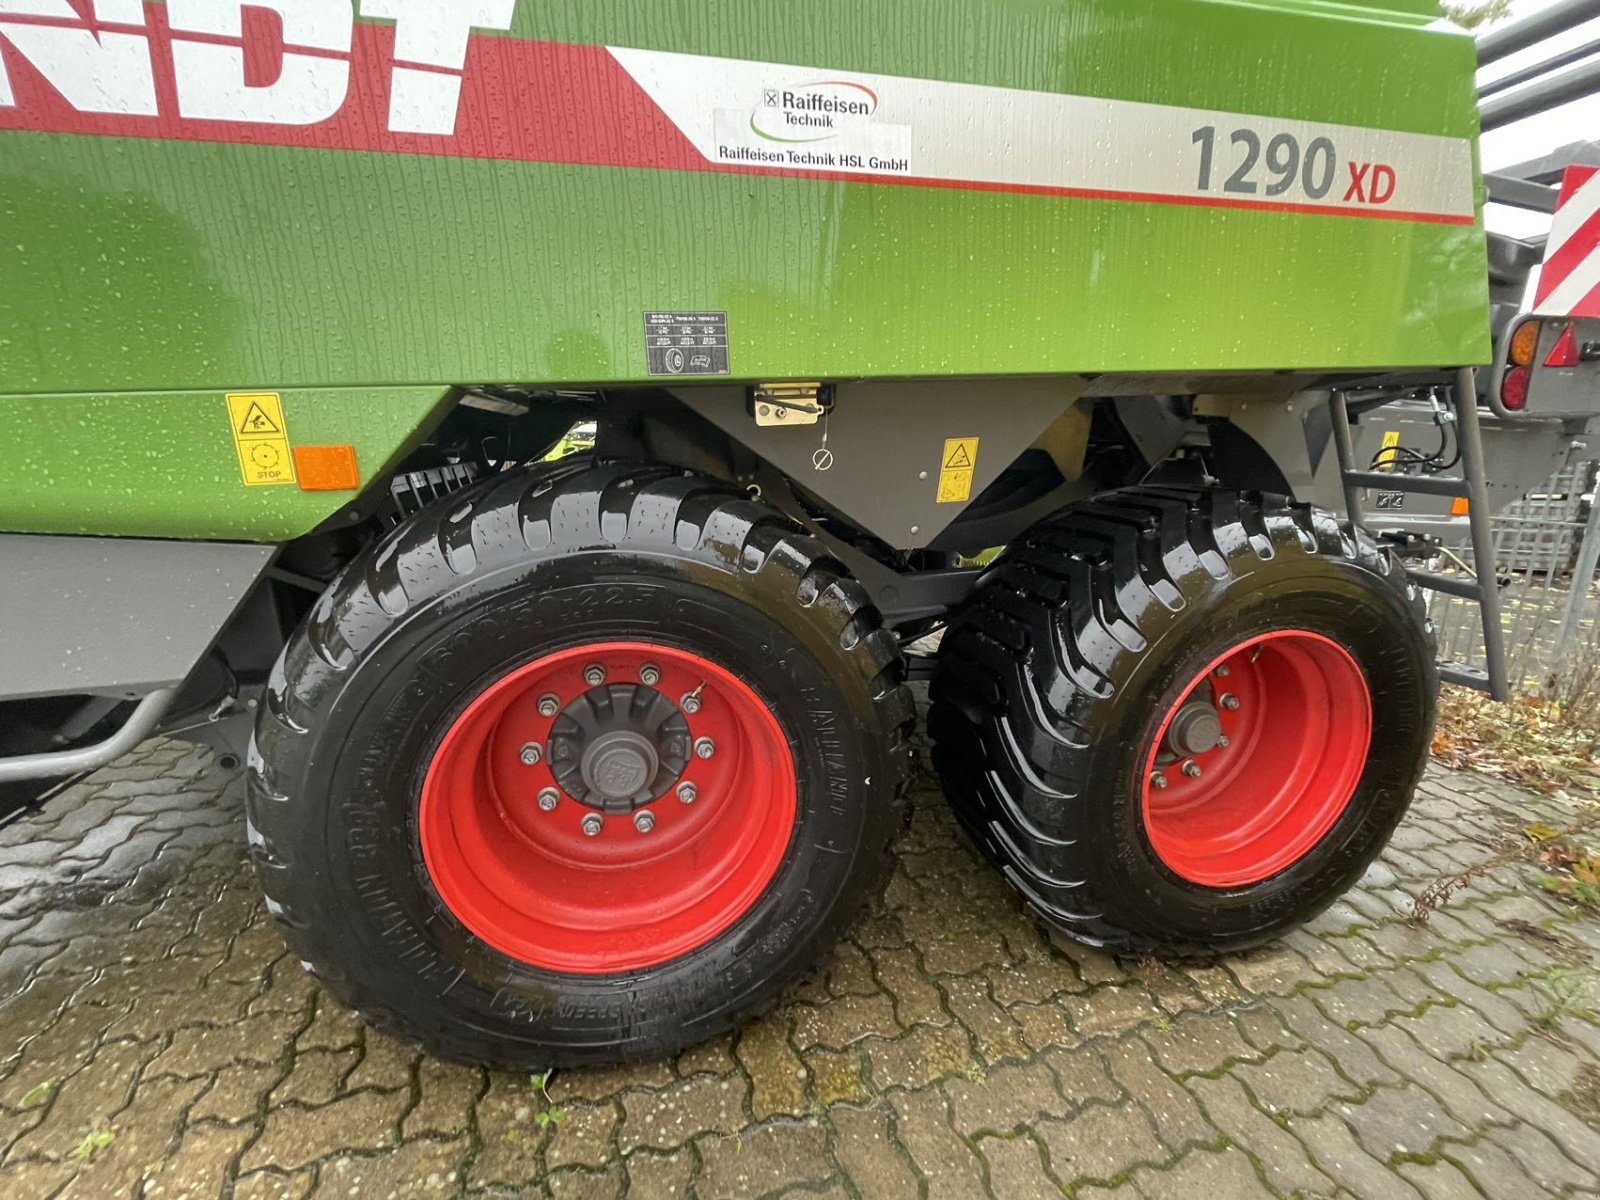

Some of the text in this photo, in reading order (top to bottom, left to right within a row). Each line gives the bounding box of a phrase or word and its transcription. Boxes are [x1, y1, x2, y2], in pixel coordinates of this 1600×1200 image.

[783, 92, 869, 115] Raiffeisen
[783, 111, 834, 128] Technik
[719, 145, 908, 171] Raiffeisen Technik HSL GmbH
[1192, 125, 1396, 204] 1290 XD
[257, 471, 282, 479] STOP
